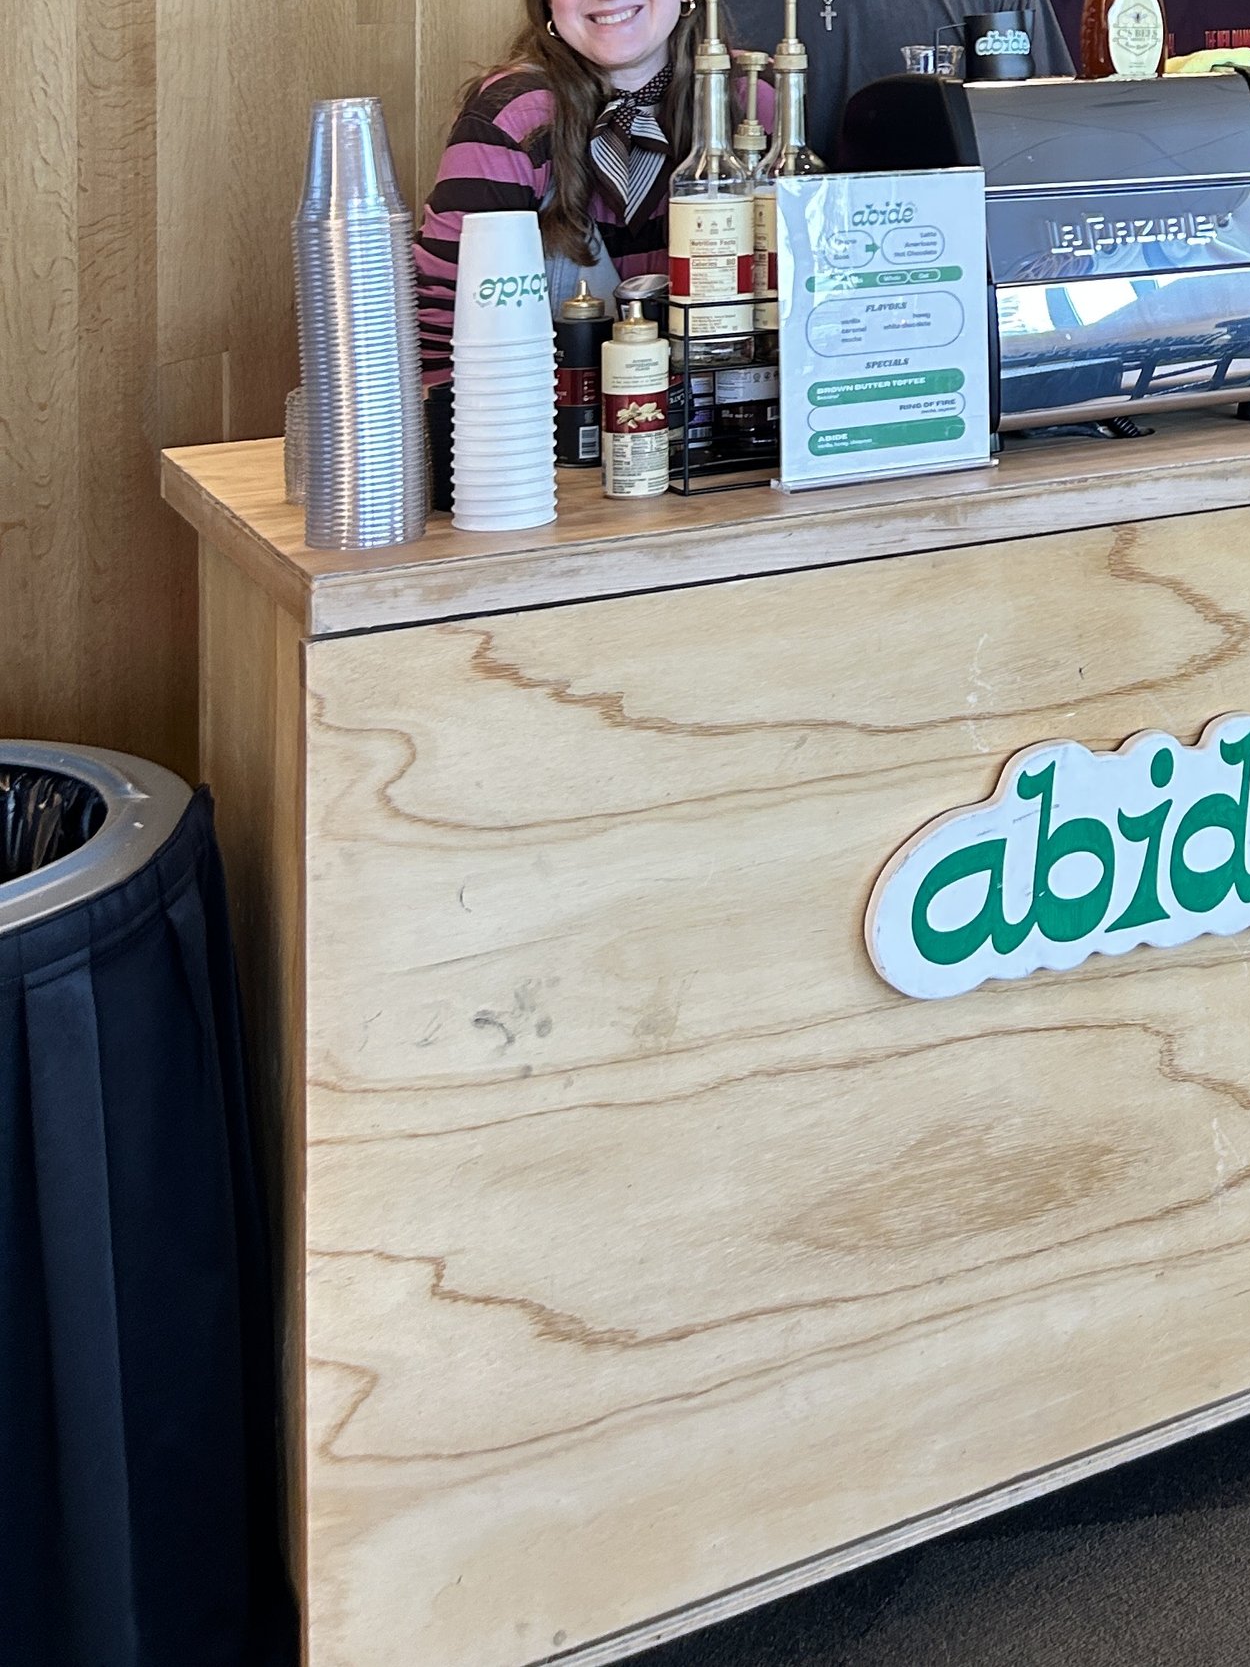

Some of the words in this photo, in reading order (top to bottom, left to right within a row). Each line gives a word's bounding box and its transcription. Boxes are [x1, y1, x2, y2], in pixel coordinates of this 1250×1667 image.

[852, 202, 914, 226] abide
[865, 302, 908, 313] FLAVORS
[864, 358, 910, 370] SPECIALS
[816, 385, 854, 395] BROWN
[854, 381, 891, 391] BUTTER
[892, 377, 926, 387] TOFFEE
[899, 402, 922, 411] RING
[935, 398, 956, 407] FIRE
[818, 433, 848, 442] ABIDE
